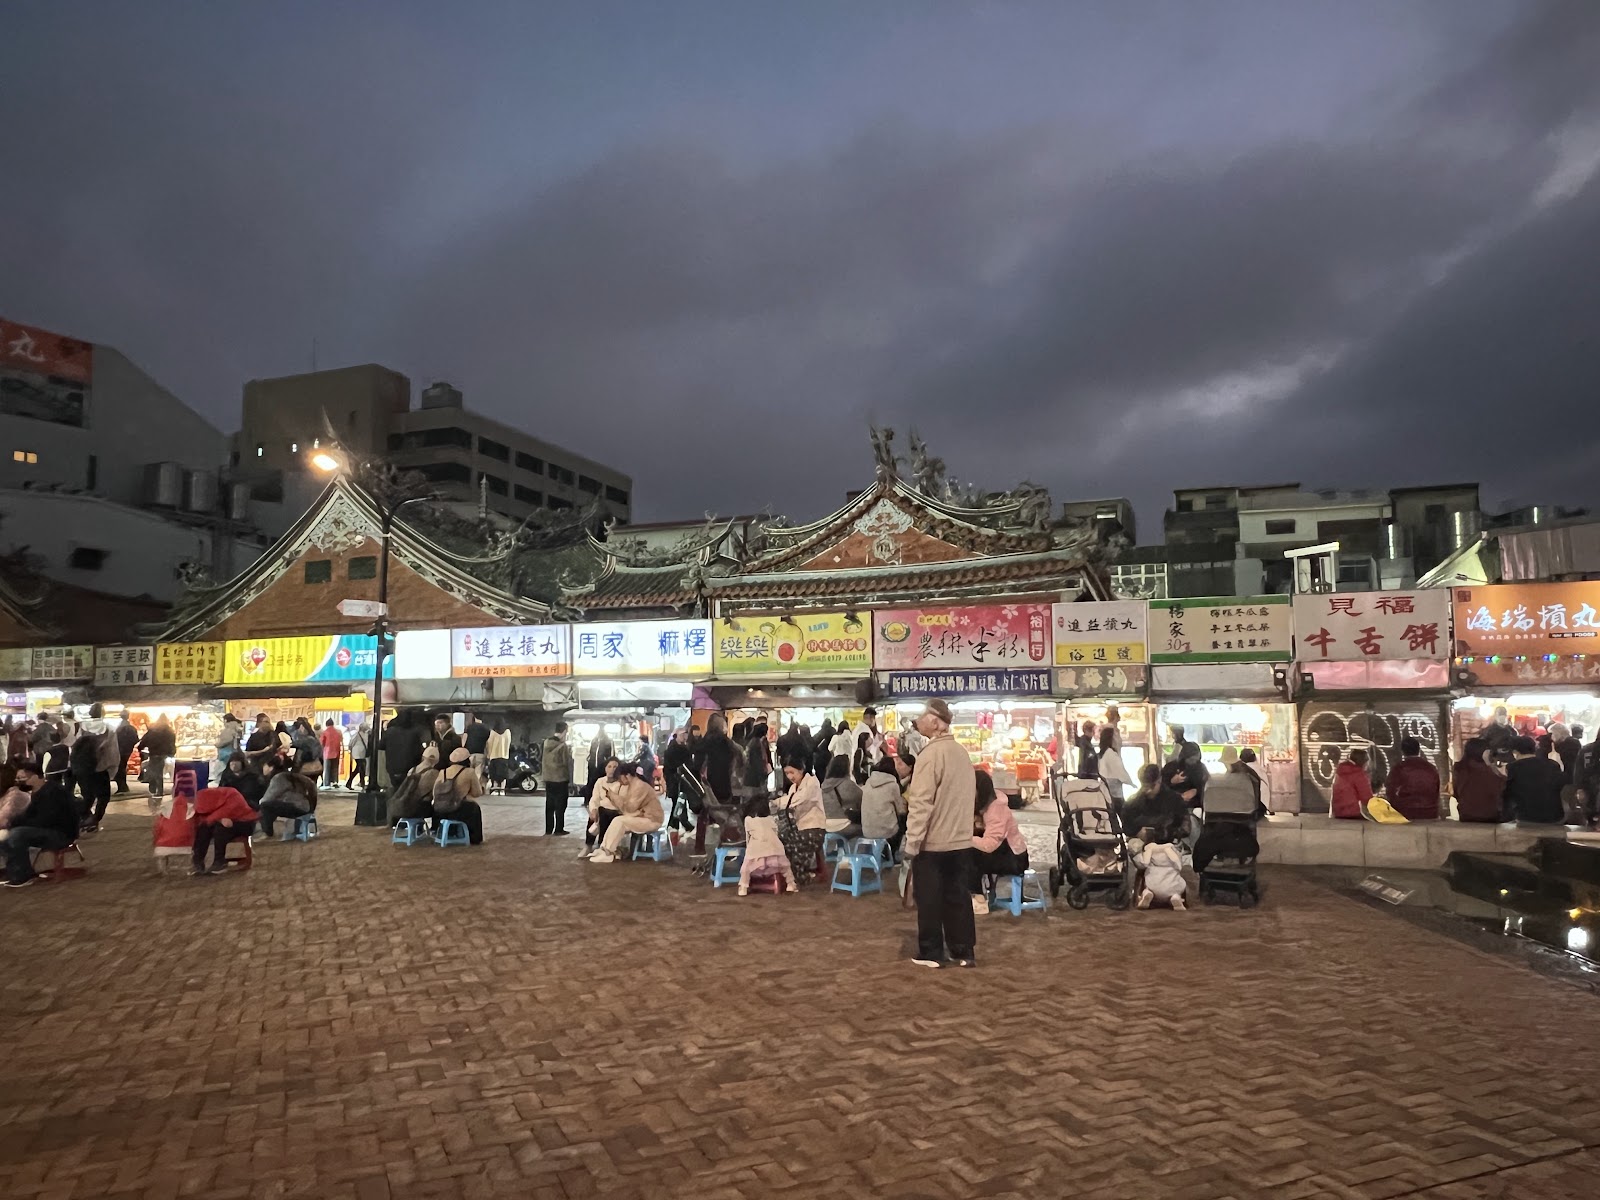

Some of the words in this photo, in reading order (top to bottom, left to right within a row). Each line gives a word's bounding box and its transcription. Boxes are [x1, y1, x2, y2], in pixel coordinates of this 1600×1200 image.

[1327, 595, 1415, 616] 見福
[578, 631, 625, 659] 周家
[720, 635, 769, 659] 樂樂
[1303, 622, 1440, 657] 牛舌餅
